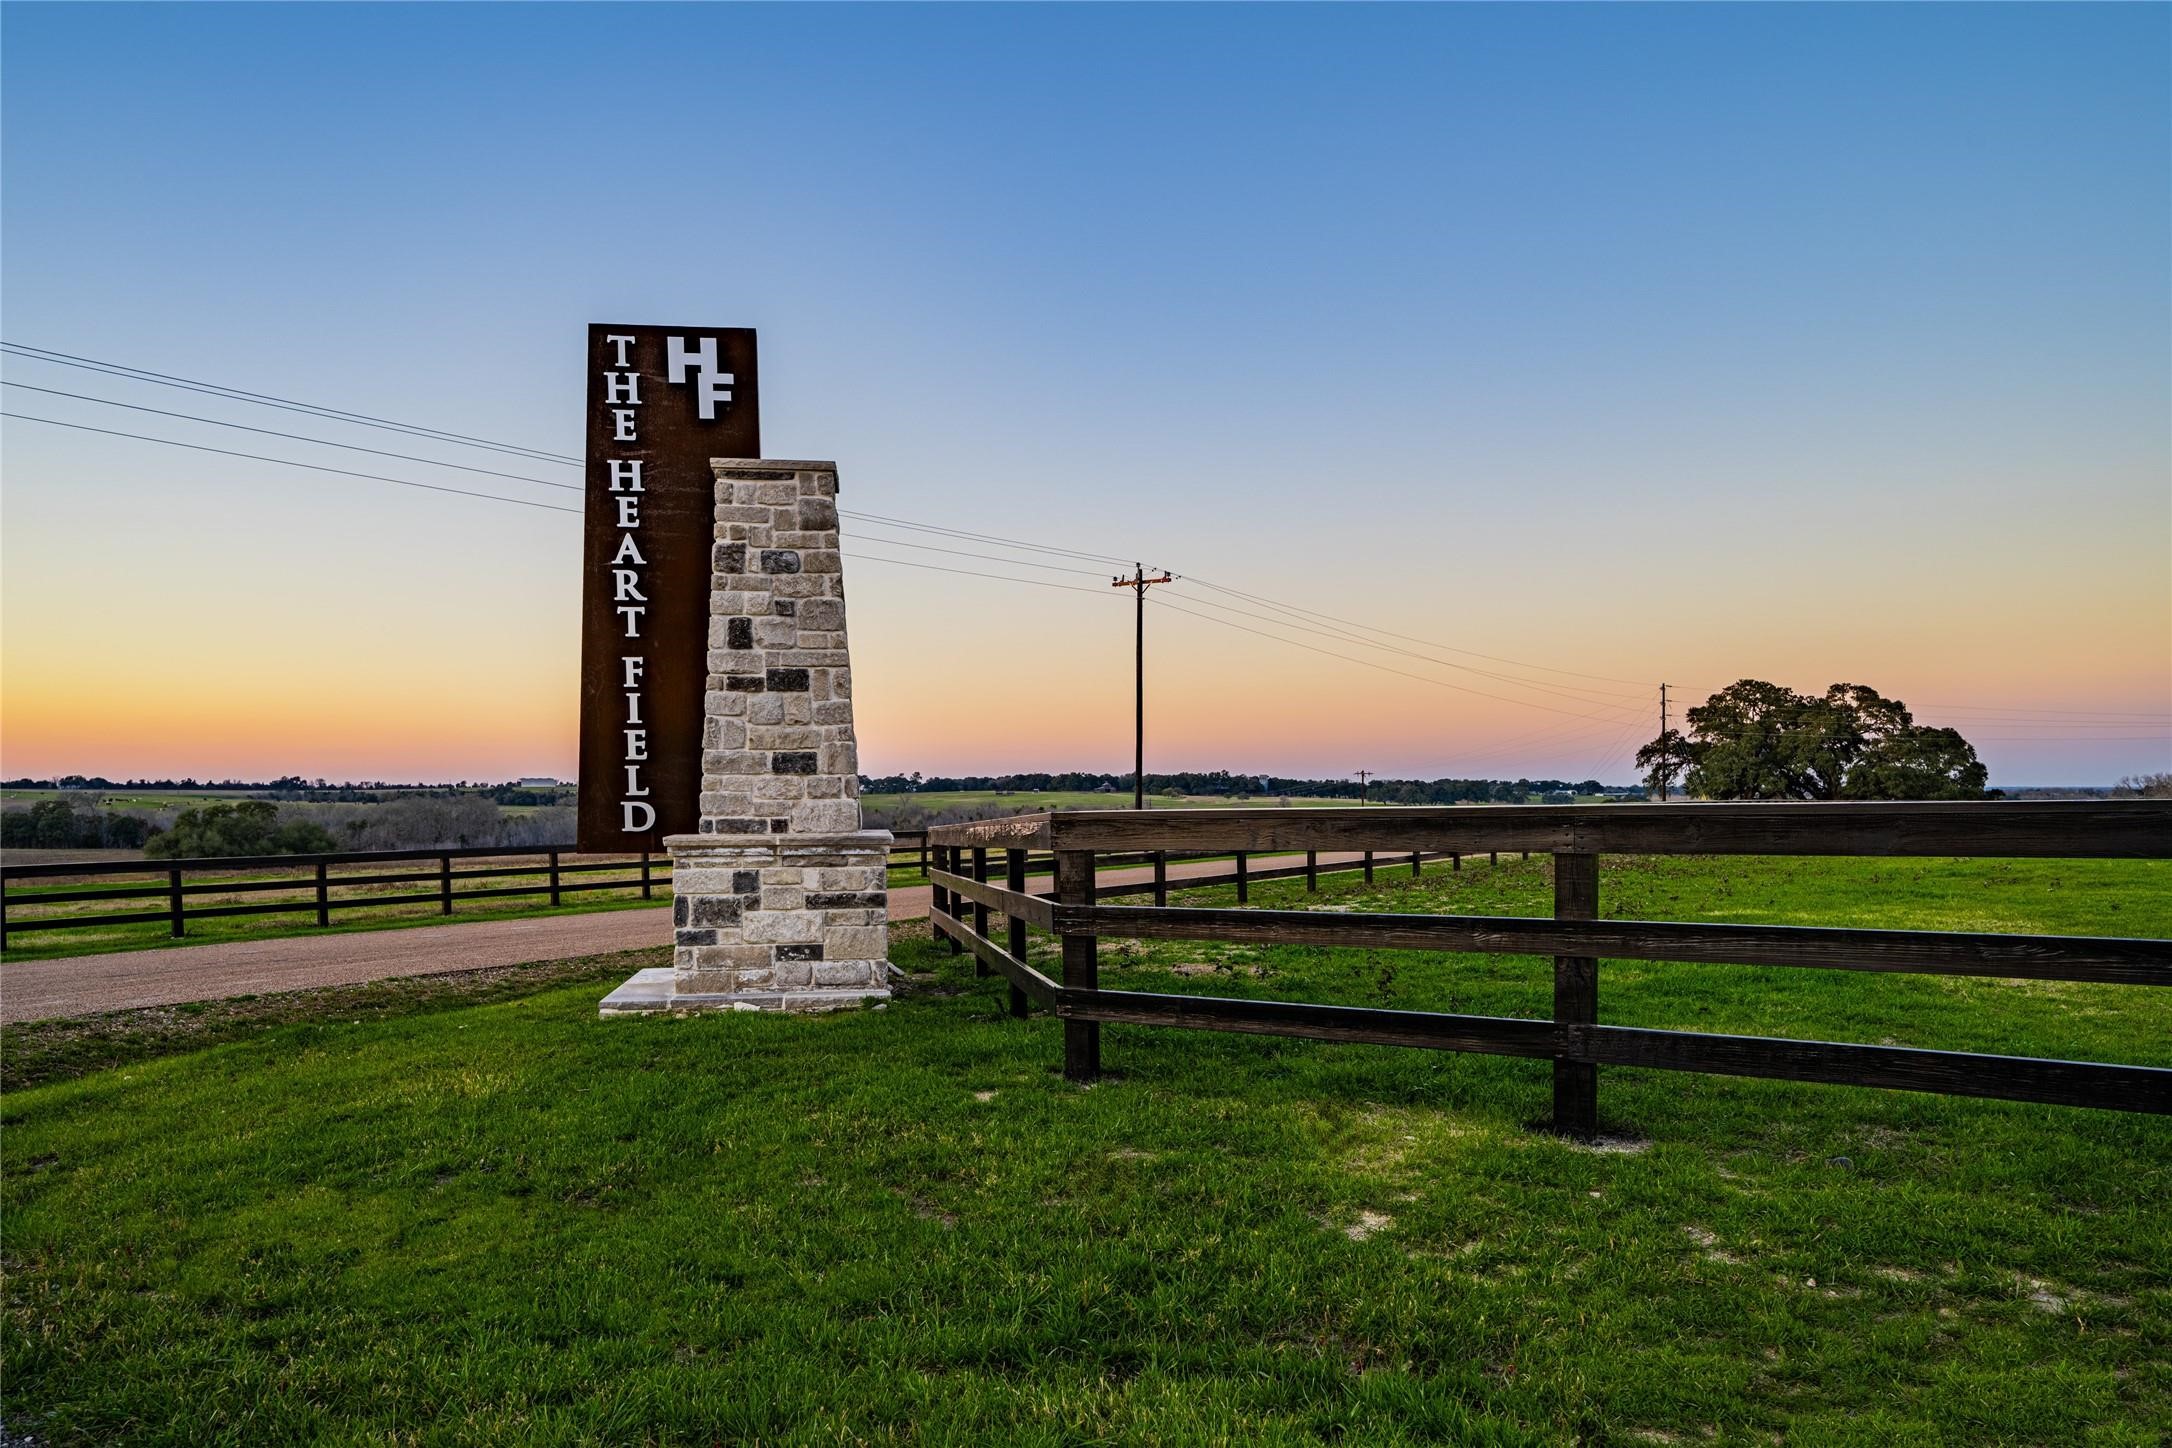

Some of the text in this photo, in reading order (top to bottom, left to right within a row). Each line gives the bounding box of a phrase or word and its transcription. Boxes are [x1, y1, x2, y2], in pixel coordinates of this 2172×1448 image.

[666, 336, 735, 420] HF
[603, 334, 656, 832] THE HEART FIELD
